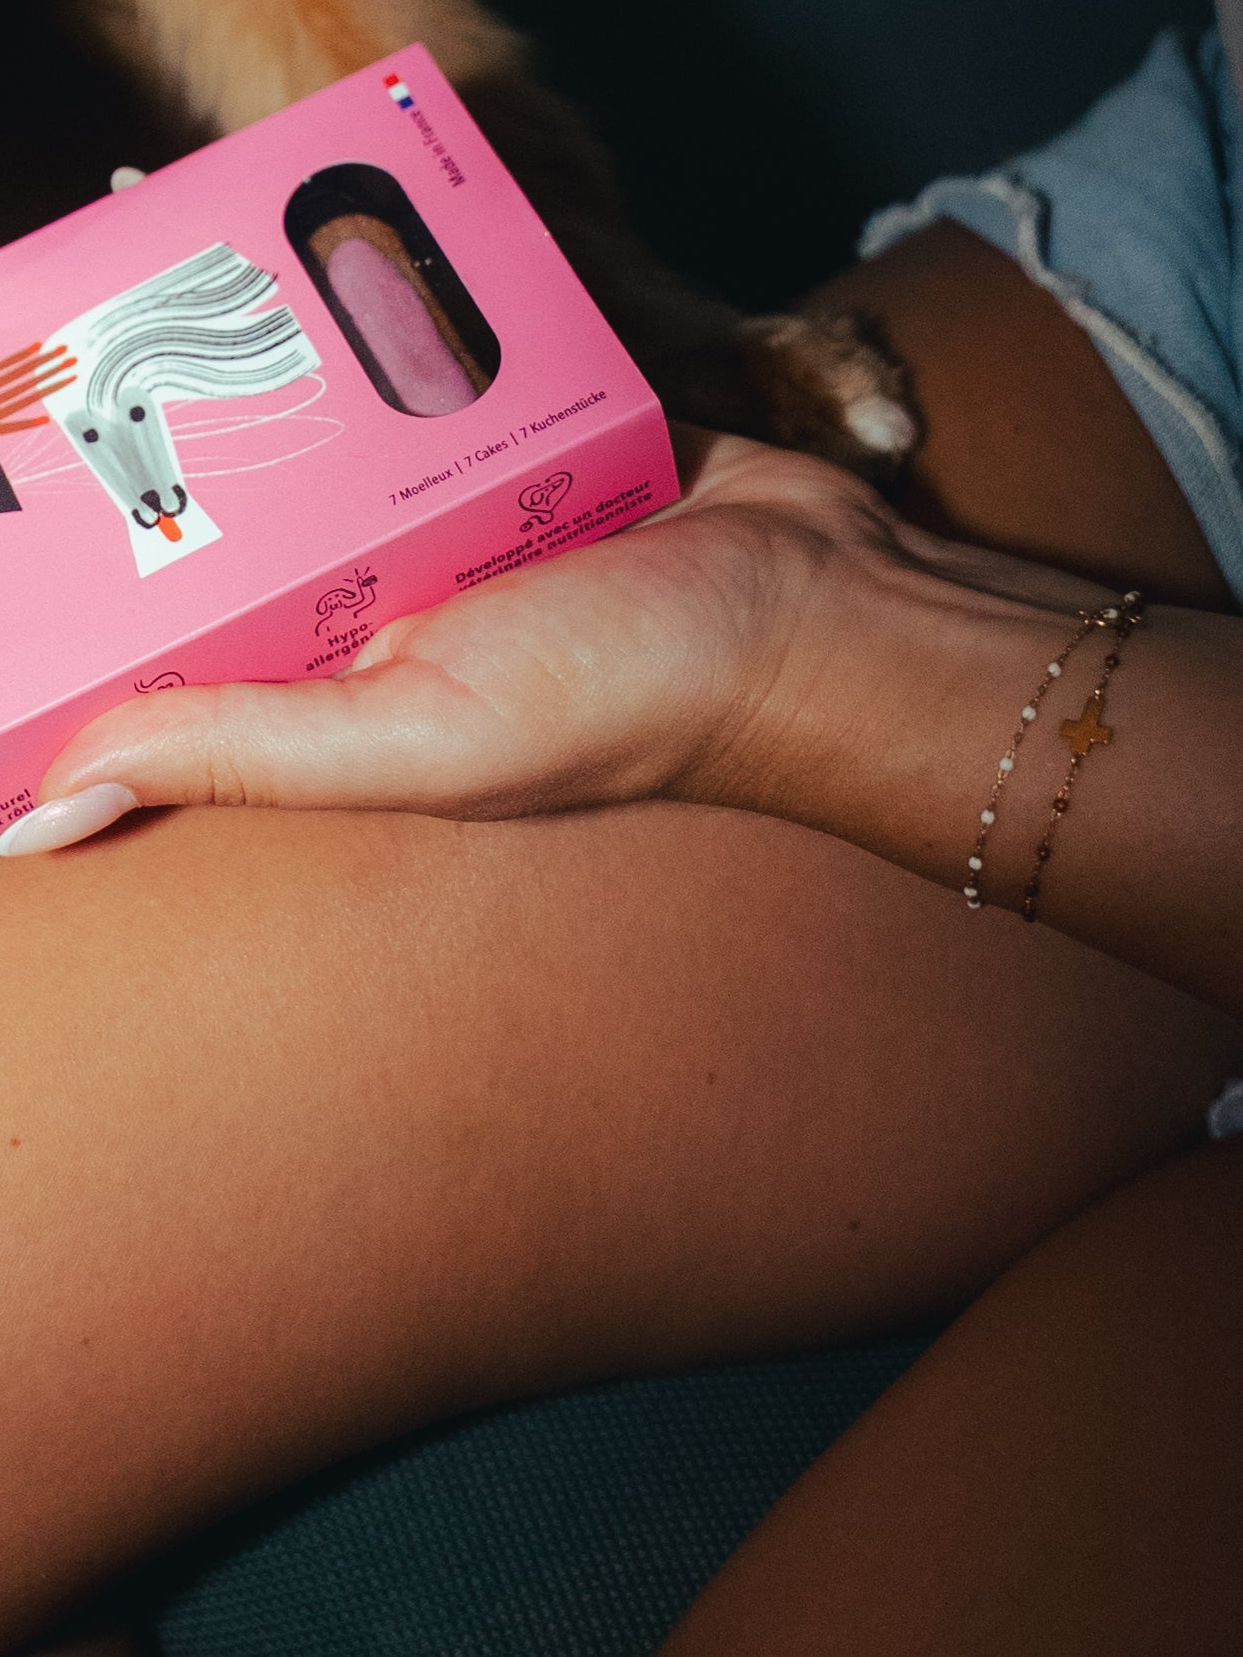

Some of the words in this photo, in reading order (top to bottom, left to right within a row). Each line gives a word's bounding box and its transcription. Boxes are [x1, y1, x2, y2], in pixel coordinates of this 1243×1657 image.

[440, 156, 465, 188] Made
[388, 494, 398, 506] 7
[399, 468, 454, 501] Moelleux
[463, 455, 473, 468] 7
[474, 439, 509, 463] Cakes
[519, 427, 529, 439] 7
[529, 390, 607, 434] Kuchenstücke
[455, 538, 533, 584] Développé
[537, 522, 570, 544] avec
[572, 510, 593, 526] un
[595, 479, 651, 513] docteur
[547, 492, 653, 550] nutritionniste
[306, 630, 374, 672] allergéni
[327, 622, 374, 647] Hypo-
[7, 800, 35, 821] rôti
